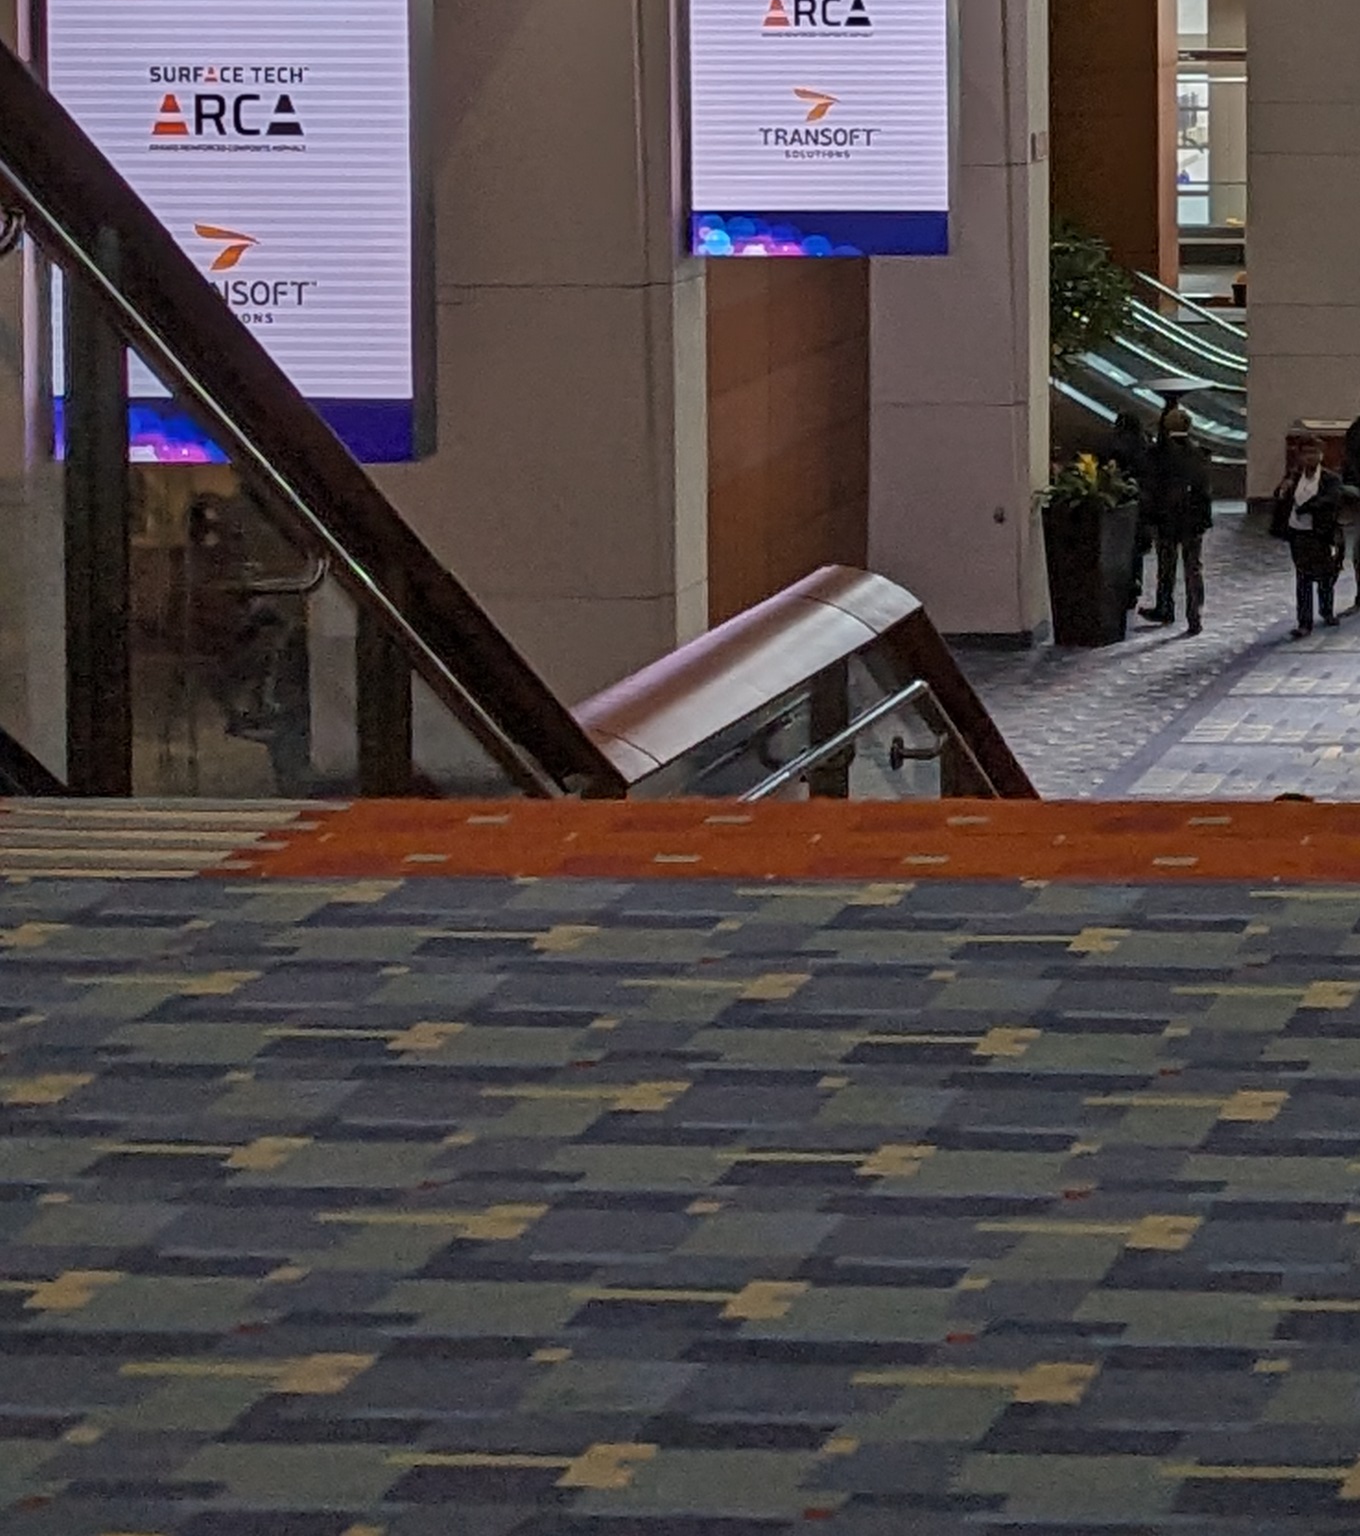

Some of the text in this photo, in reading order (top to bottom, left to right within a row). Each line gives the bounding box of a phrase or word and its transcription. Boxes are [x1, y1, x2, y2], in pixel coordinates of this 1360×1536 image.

[150, 67, 303, 83] SURFACE TECH
[152, 94, 304, 135] ARCA
[760, 128, 873, 146] TRANSOFT
